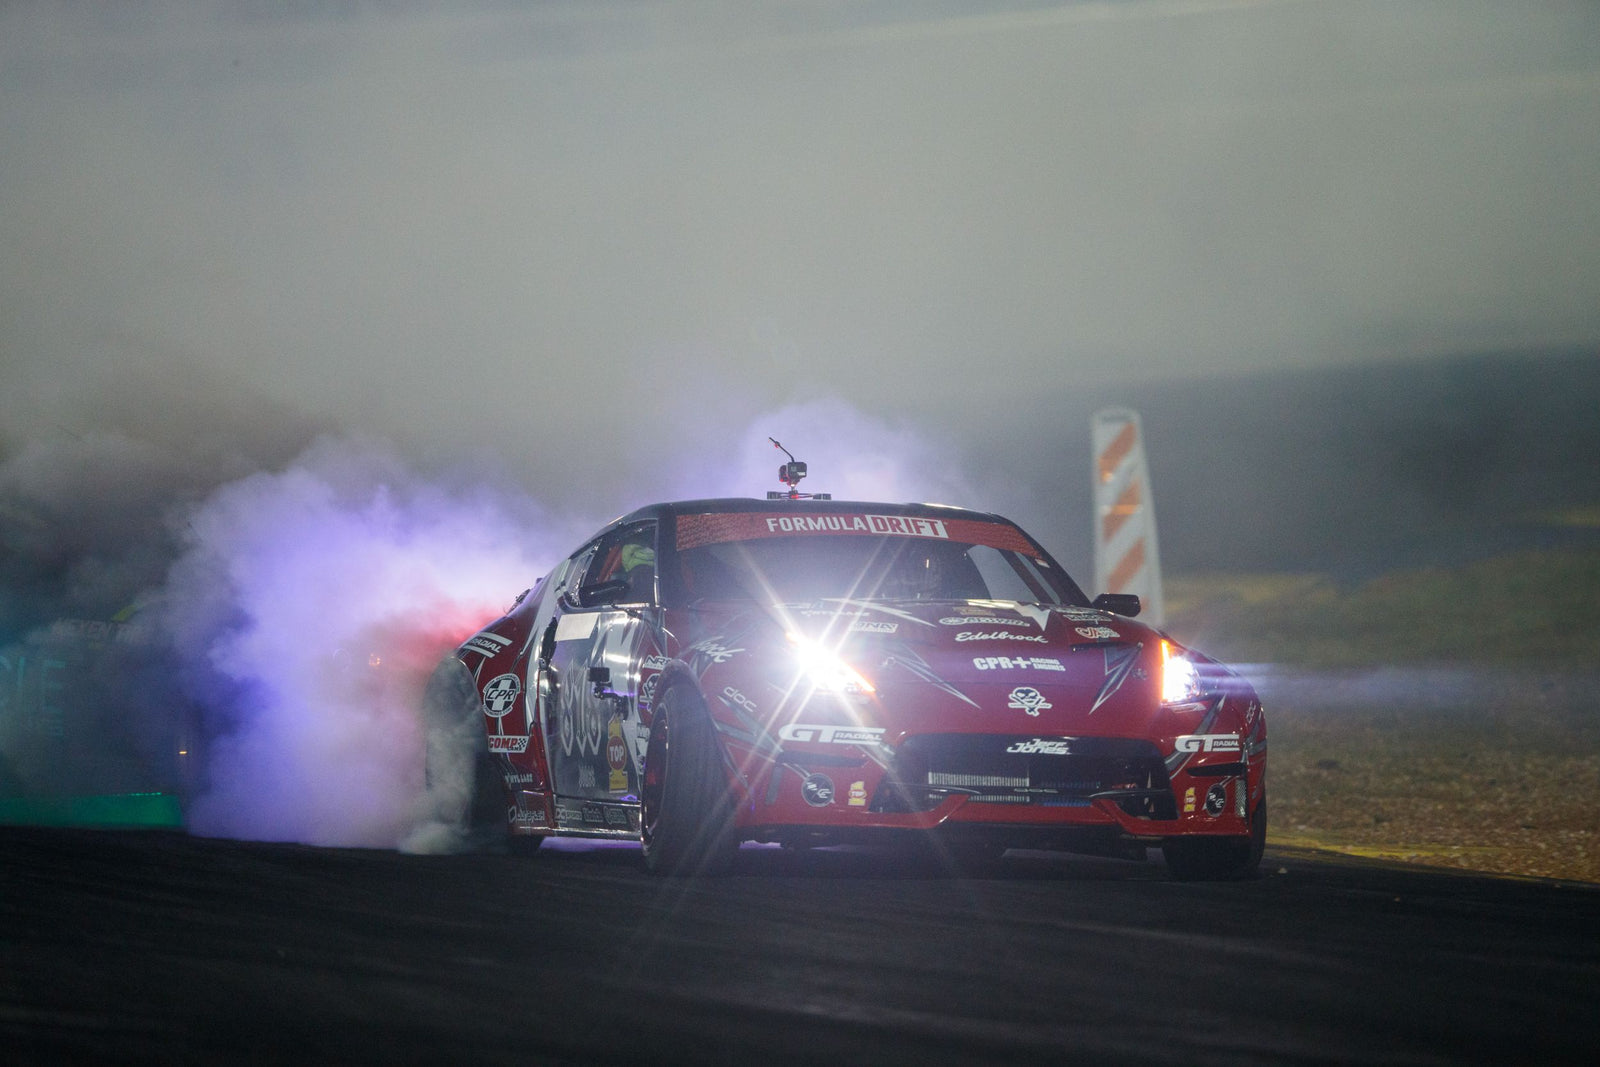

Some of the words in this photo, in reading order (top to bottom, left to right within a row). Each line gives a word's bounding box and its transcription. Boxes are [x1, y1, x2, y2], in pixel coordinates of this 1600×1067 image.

[765, 516, 868, 533] FORMULA
[869, 515, 945, 538] DRIFT
[955, 631, 1048, 643] Edelbrock
[487, 689, 515, 701] CPR
[780, 723, 843, 744] GT
[834, 731, 884, 741] RADIAL
[488, 737, 519, 749] COMP
[1174, 733, 1219, 753] GT
[1212, 739, 1240, 748] RADIAL
[608, 745, 625, 762] TOP
